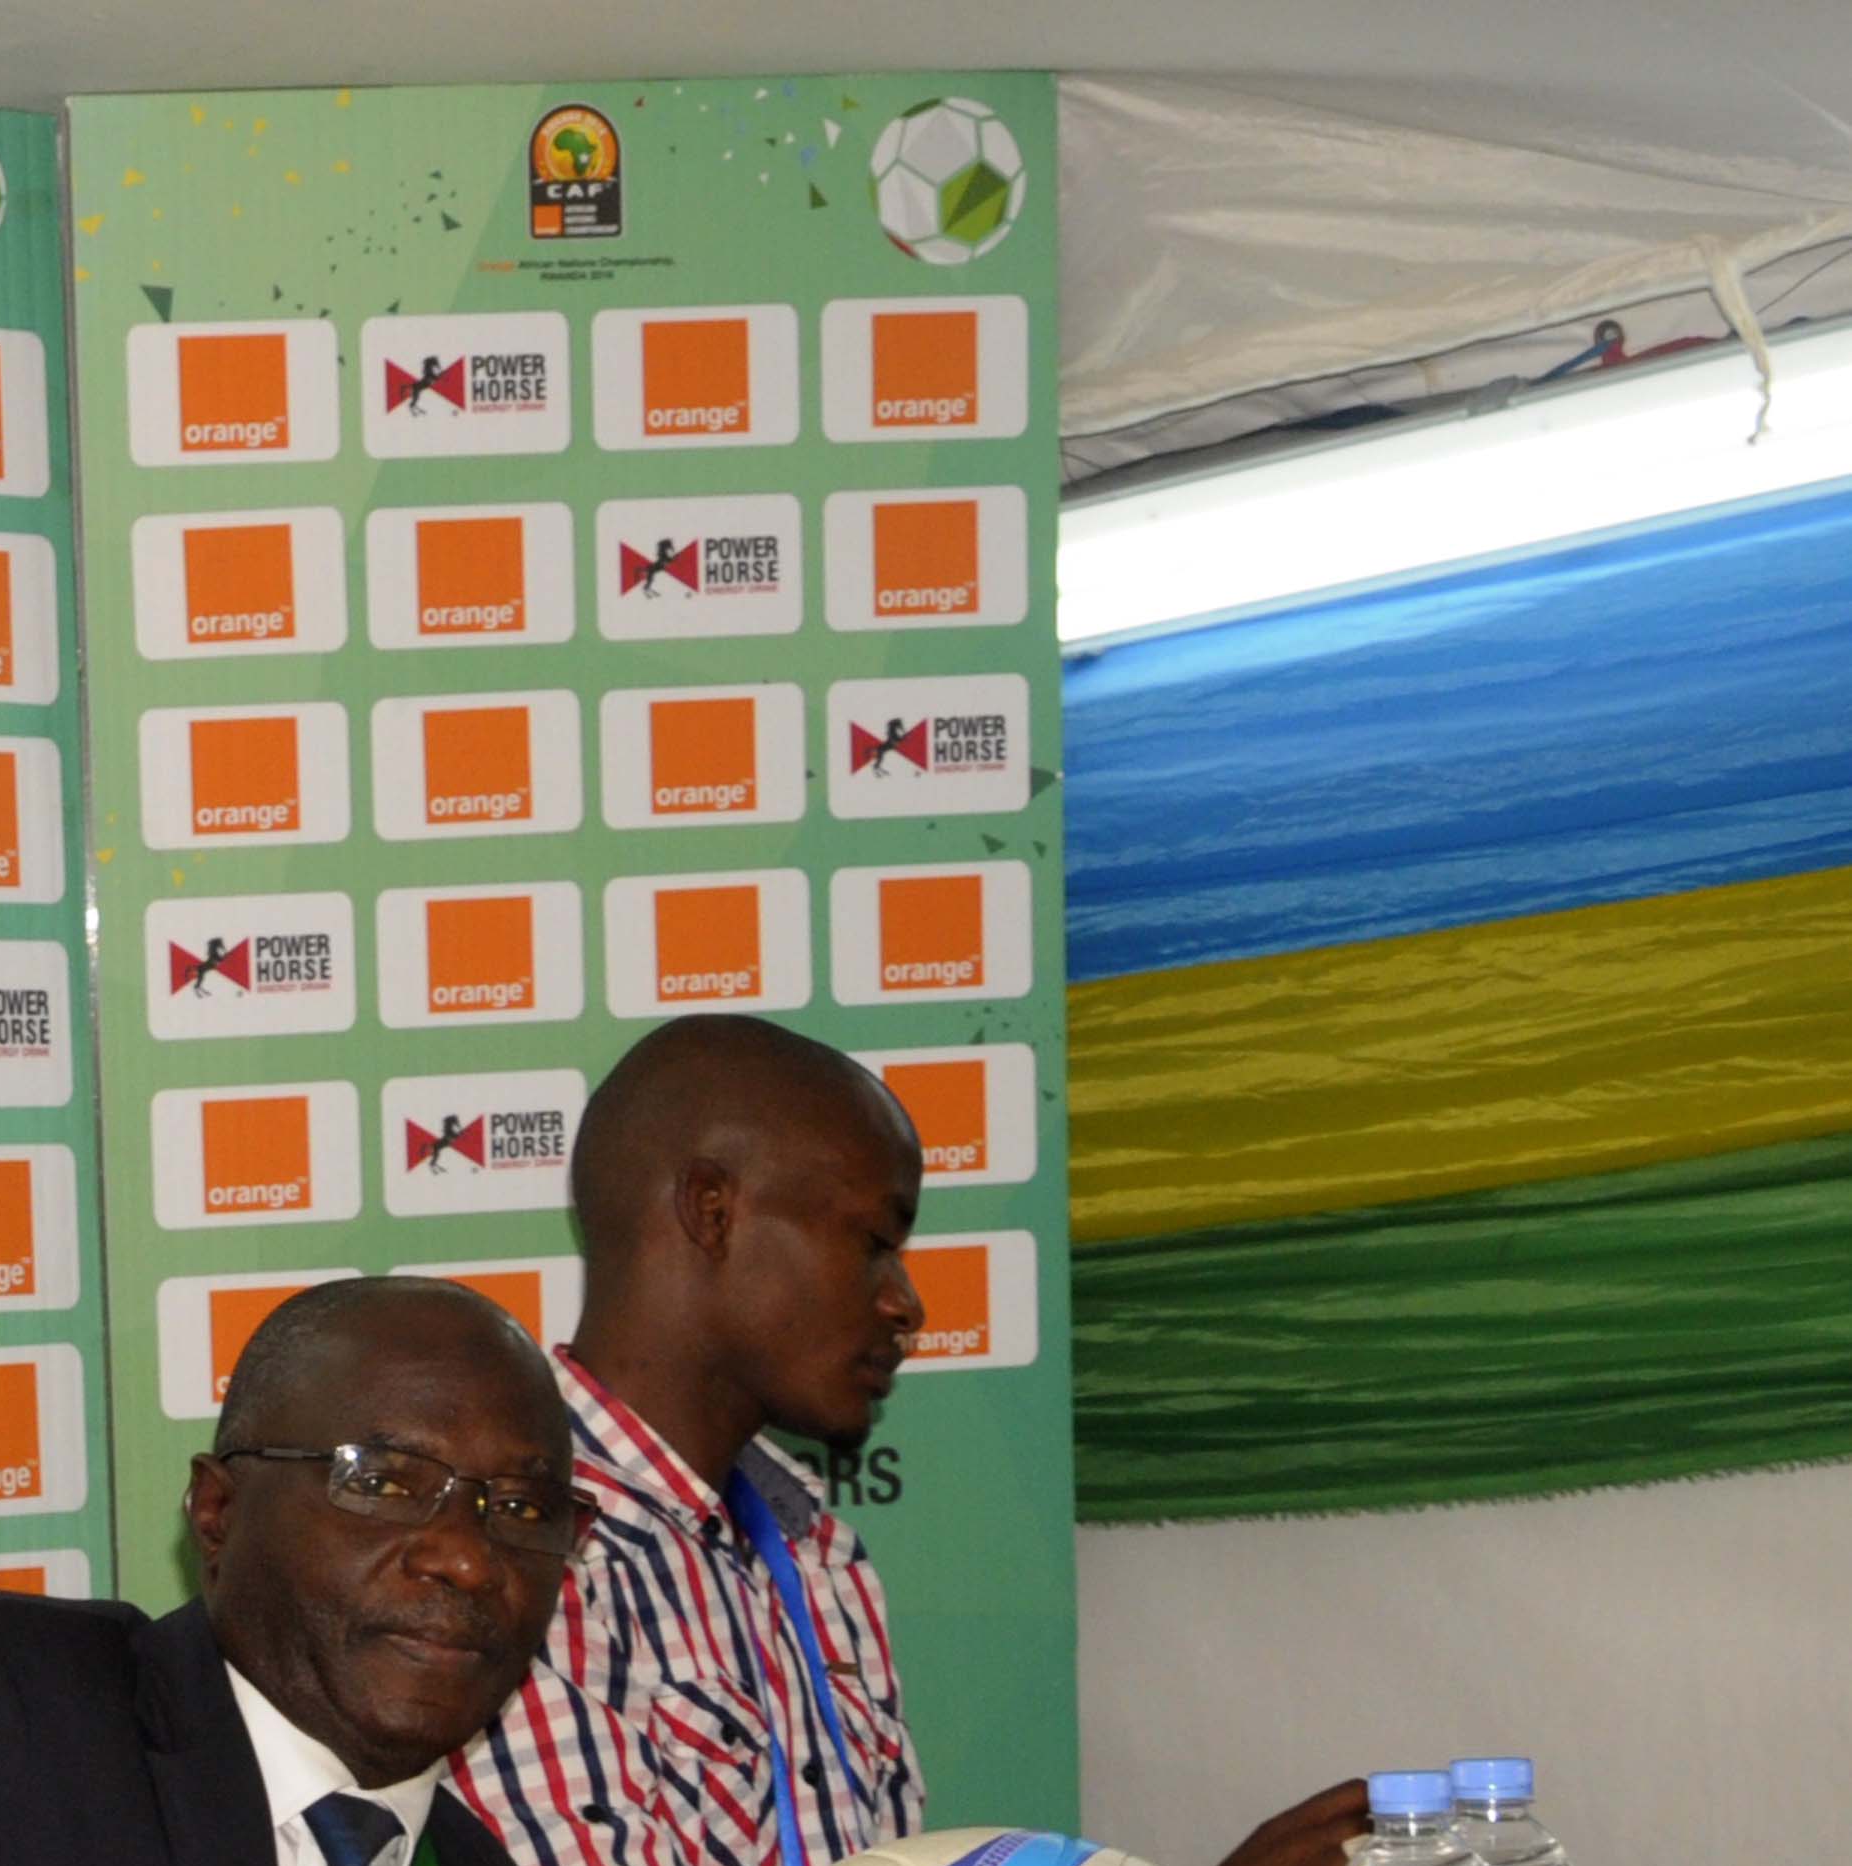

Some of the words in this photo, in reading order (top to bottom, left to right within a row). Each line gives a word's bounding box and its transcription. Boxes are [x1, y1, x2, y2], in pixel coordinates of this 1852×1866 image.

[472, 355, 544, 378] POWER
[473, 378, 545, 402] HORSE
[706, 536, 777, 560] POWER
[706, 560, 777, 583] HORSE
[935, 716, 1005, 739] POWER
[935, 739, 1004, 762] HORSE
[257, 934, 329, 958] POWER
[257, 958, 330, 982] HORSE
[491, 1111, 562, 1135] POWER
[492, 1135, 563, 1158] HORSE
